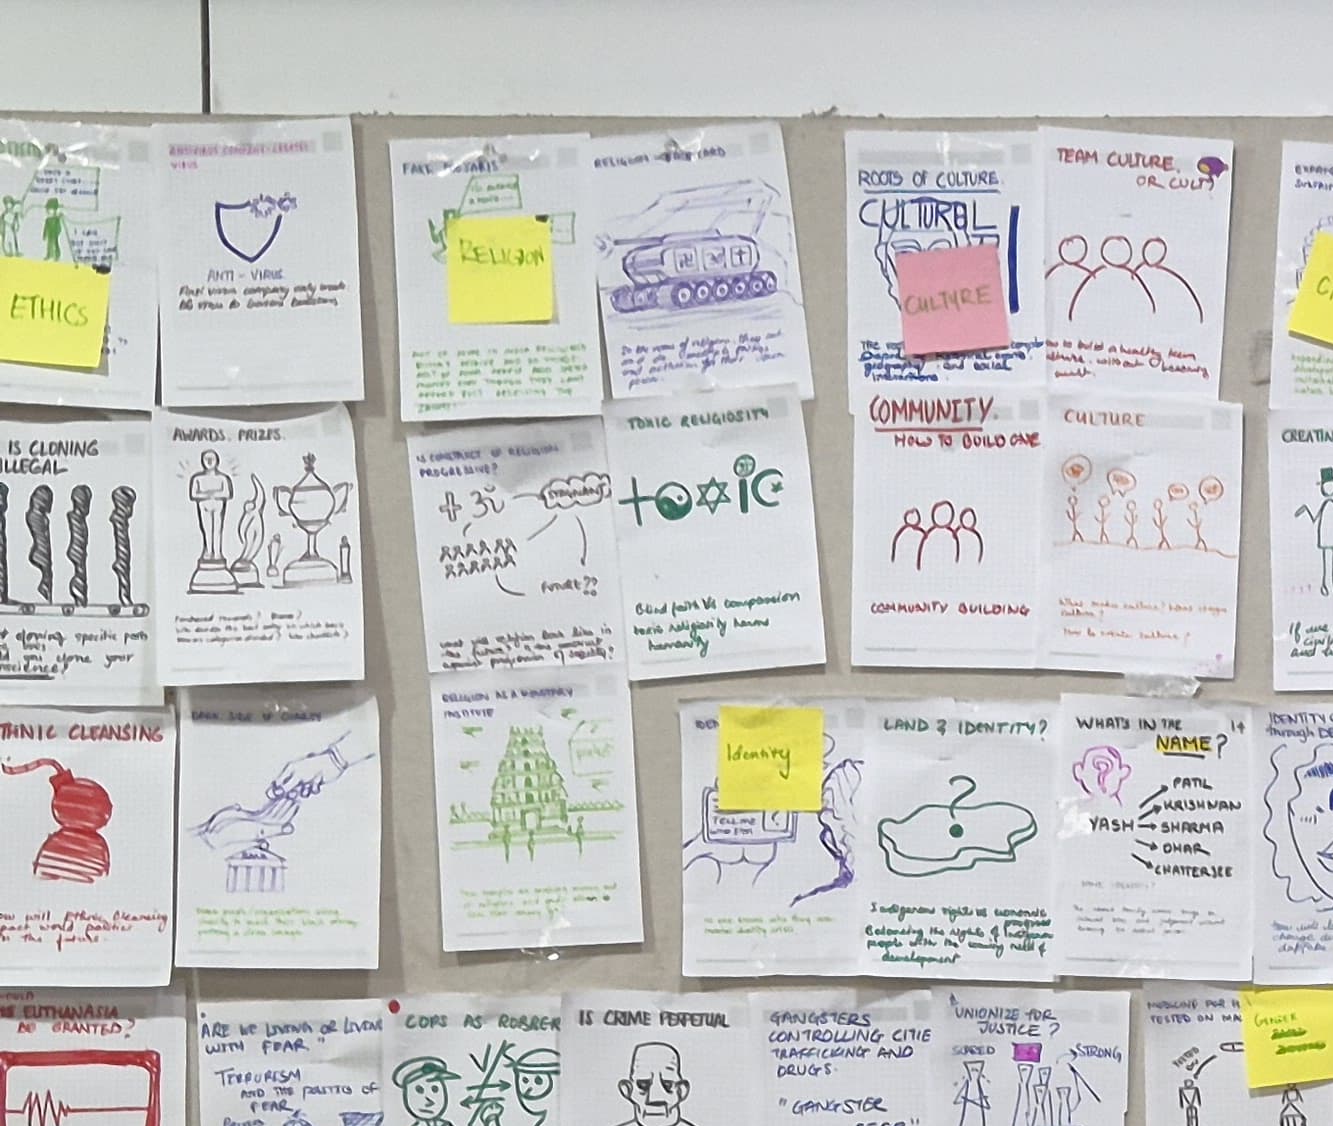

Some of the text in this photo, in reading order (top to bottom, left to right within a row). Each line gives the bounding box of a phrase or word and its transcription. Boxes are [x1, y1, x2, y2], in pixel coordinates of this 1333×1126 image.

[1056, 147, 1099, 164] TEAM
[459, 238, 545, 267] RELIGION
[902, 284, 993, 316] CULTURE
[10, 293, 89, 327] ETHICS
[626, 407, 769, 431] TOXIC RELIGIOSITY
[1063, 408, 1145, 427] CULTURE
[8, 439, 99, 458] IS CLONING
[894, 433, 933, 448] HOW
[937, 433, 953, 448] TO
[0, 457, 68, 476] ILLEGAL
[958, 602, 1030, 617] BUILDING
[67, 723, 164, 743] CLEANSING
[883, 717, 930, 733] LAND
[958, 718, 1048, 738] IDENTITY?
[1138, 718, 1157, 731] IN
[726, 743, 791, 781] Identity
[1172, 776, 1213, 791] PATIL
[1163, 799, 1242, 812] KRISHNAN
[1089, 815, 1225, 834] YASH SHARMA
[404, 1014, 448, 1030] COPS
[463, 1014, 483, 1030] AS
[578, 1009, 730, 1029] IS CRIME PERPETUAL
